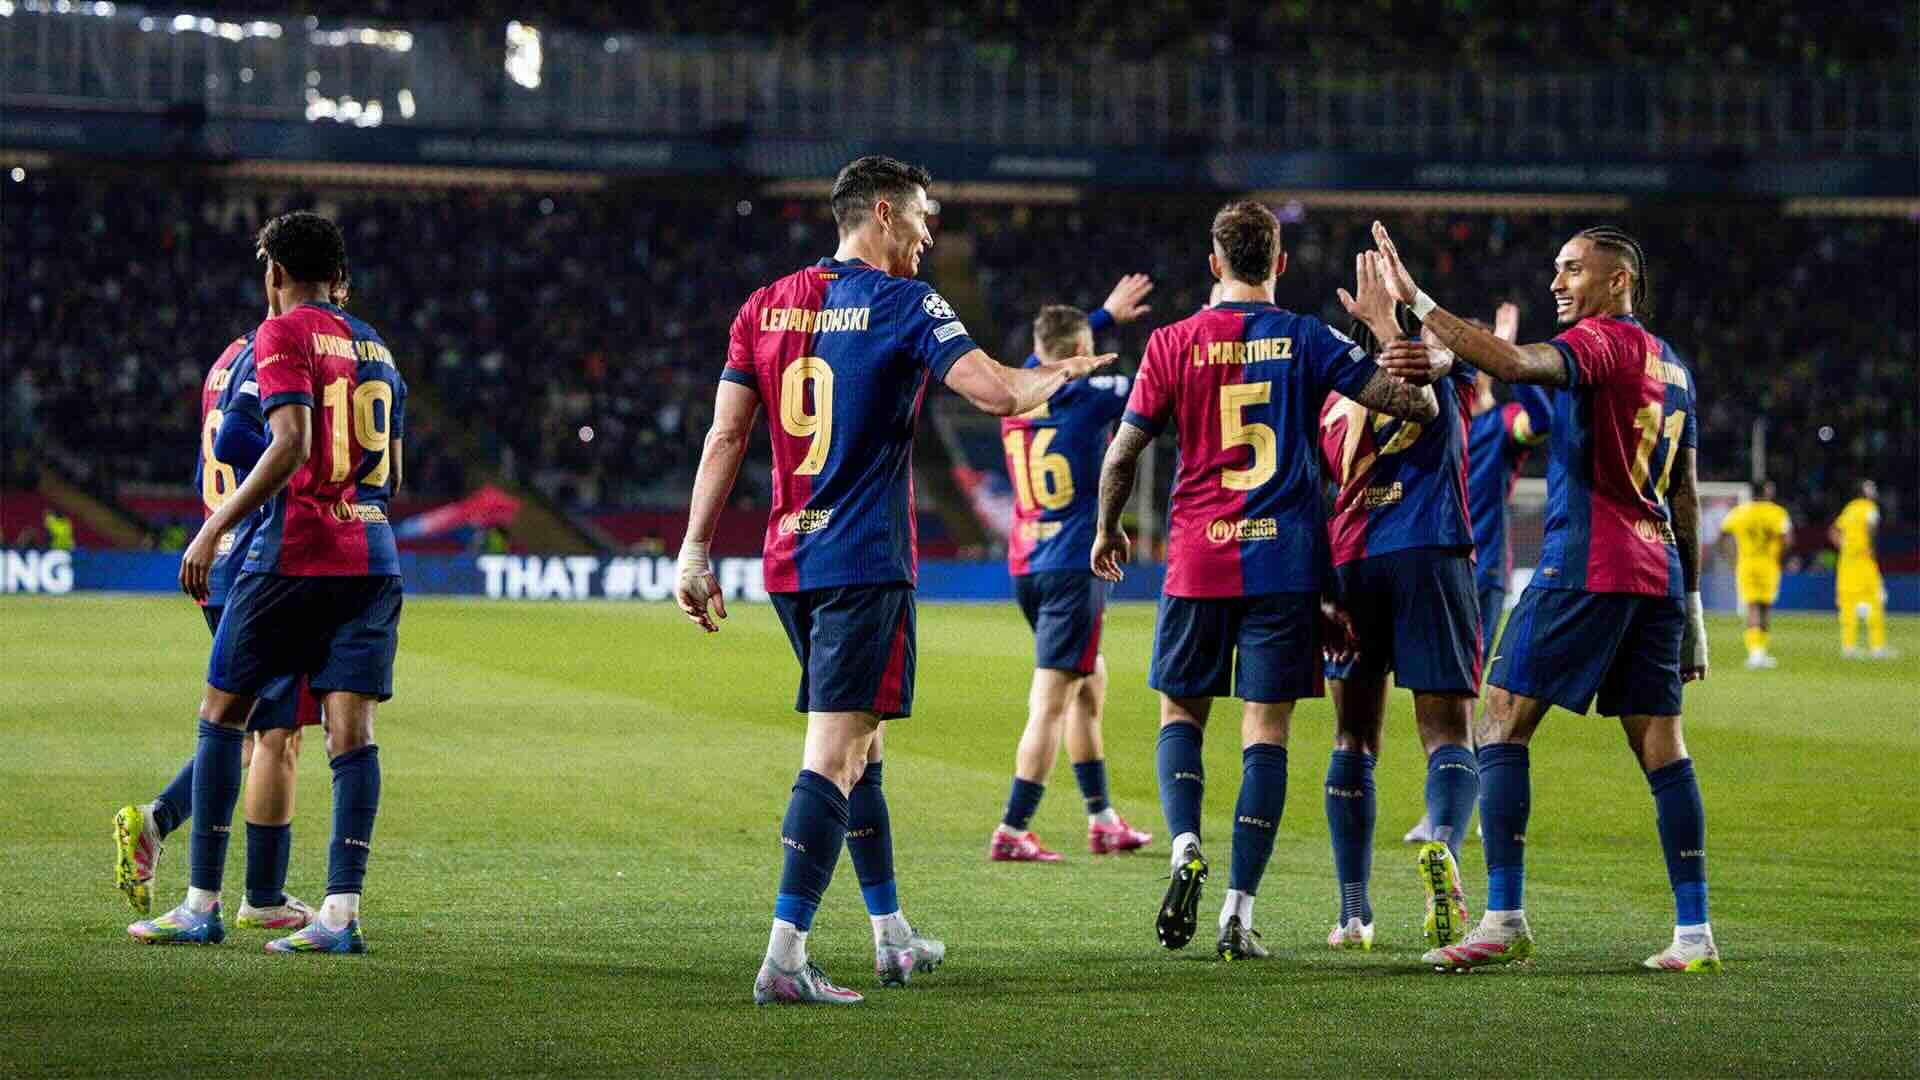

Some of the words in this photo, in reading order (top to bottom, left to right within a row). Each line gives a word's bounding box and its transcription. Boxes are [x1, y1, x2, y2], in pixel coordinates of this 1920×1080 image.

[1208, 337, 1293, 365] MARTINEZ
[322, 376, 393, 488] 19
[780, 356, 834, 475] 9
[1219, 381, 1277, 490] 5
[1631, 400, 1687, 506] 11
[1003, 427, 1073, 511] 16
[477, 554, 598, 600] THAT
